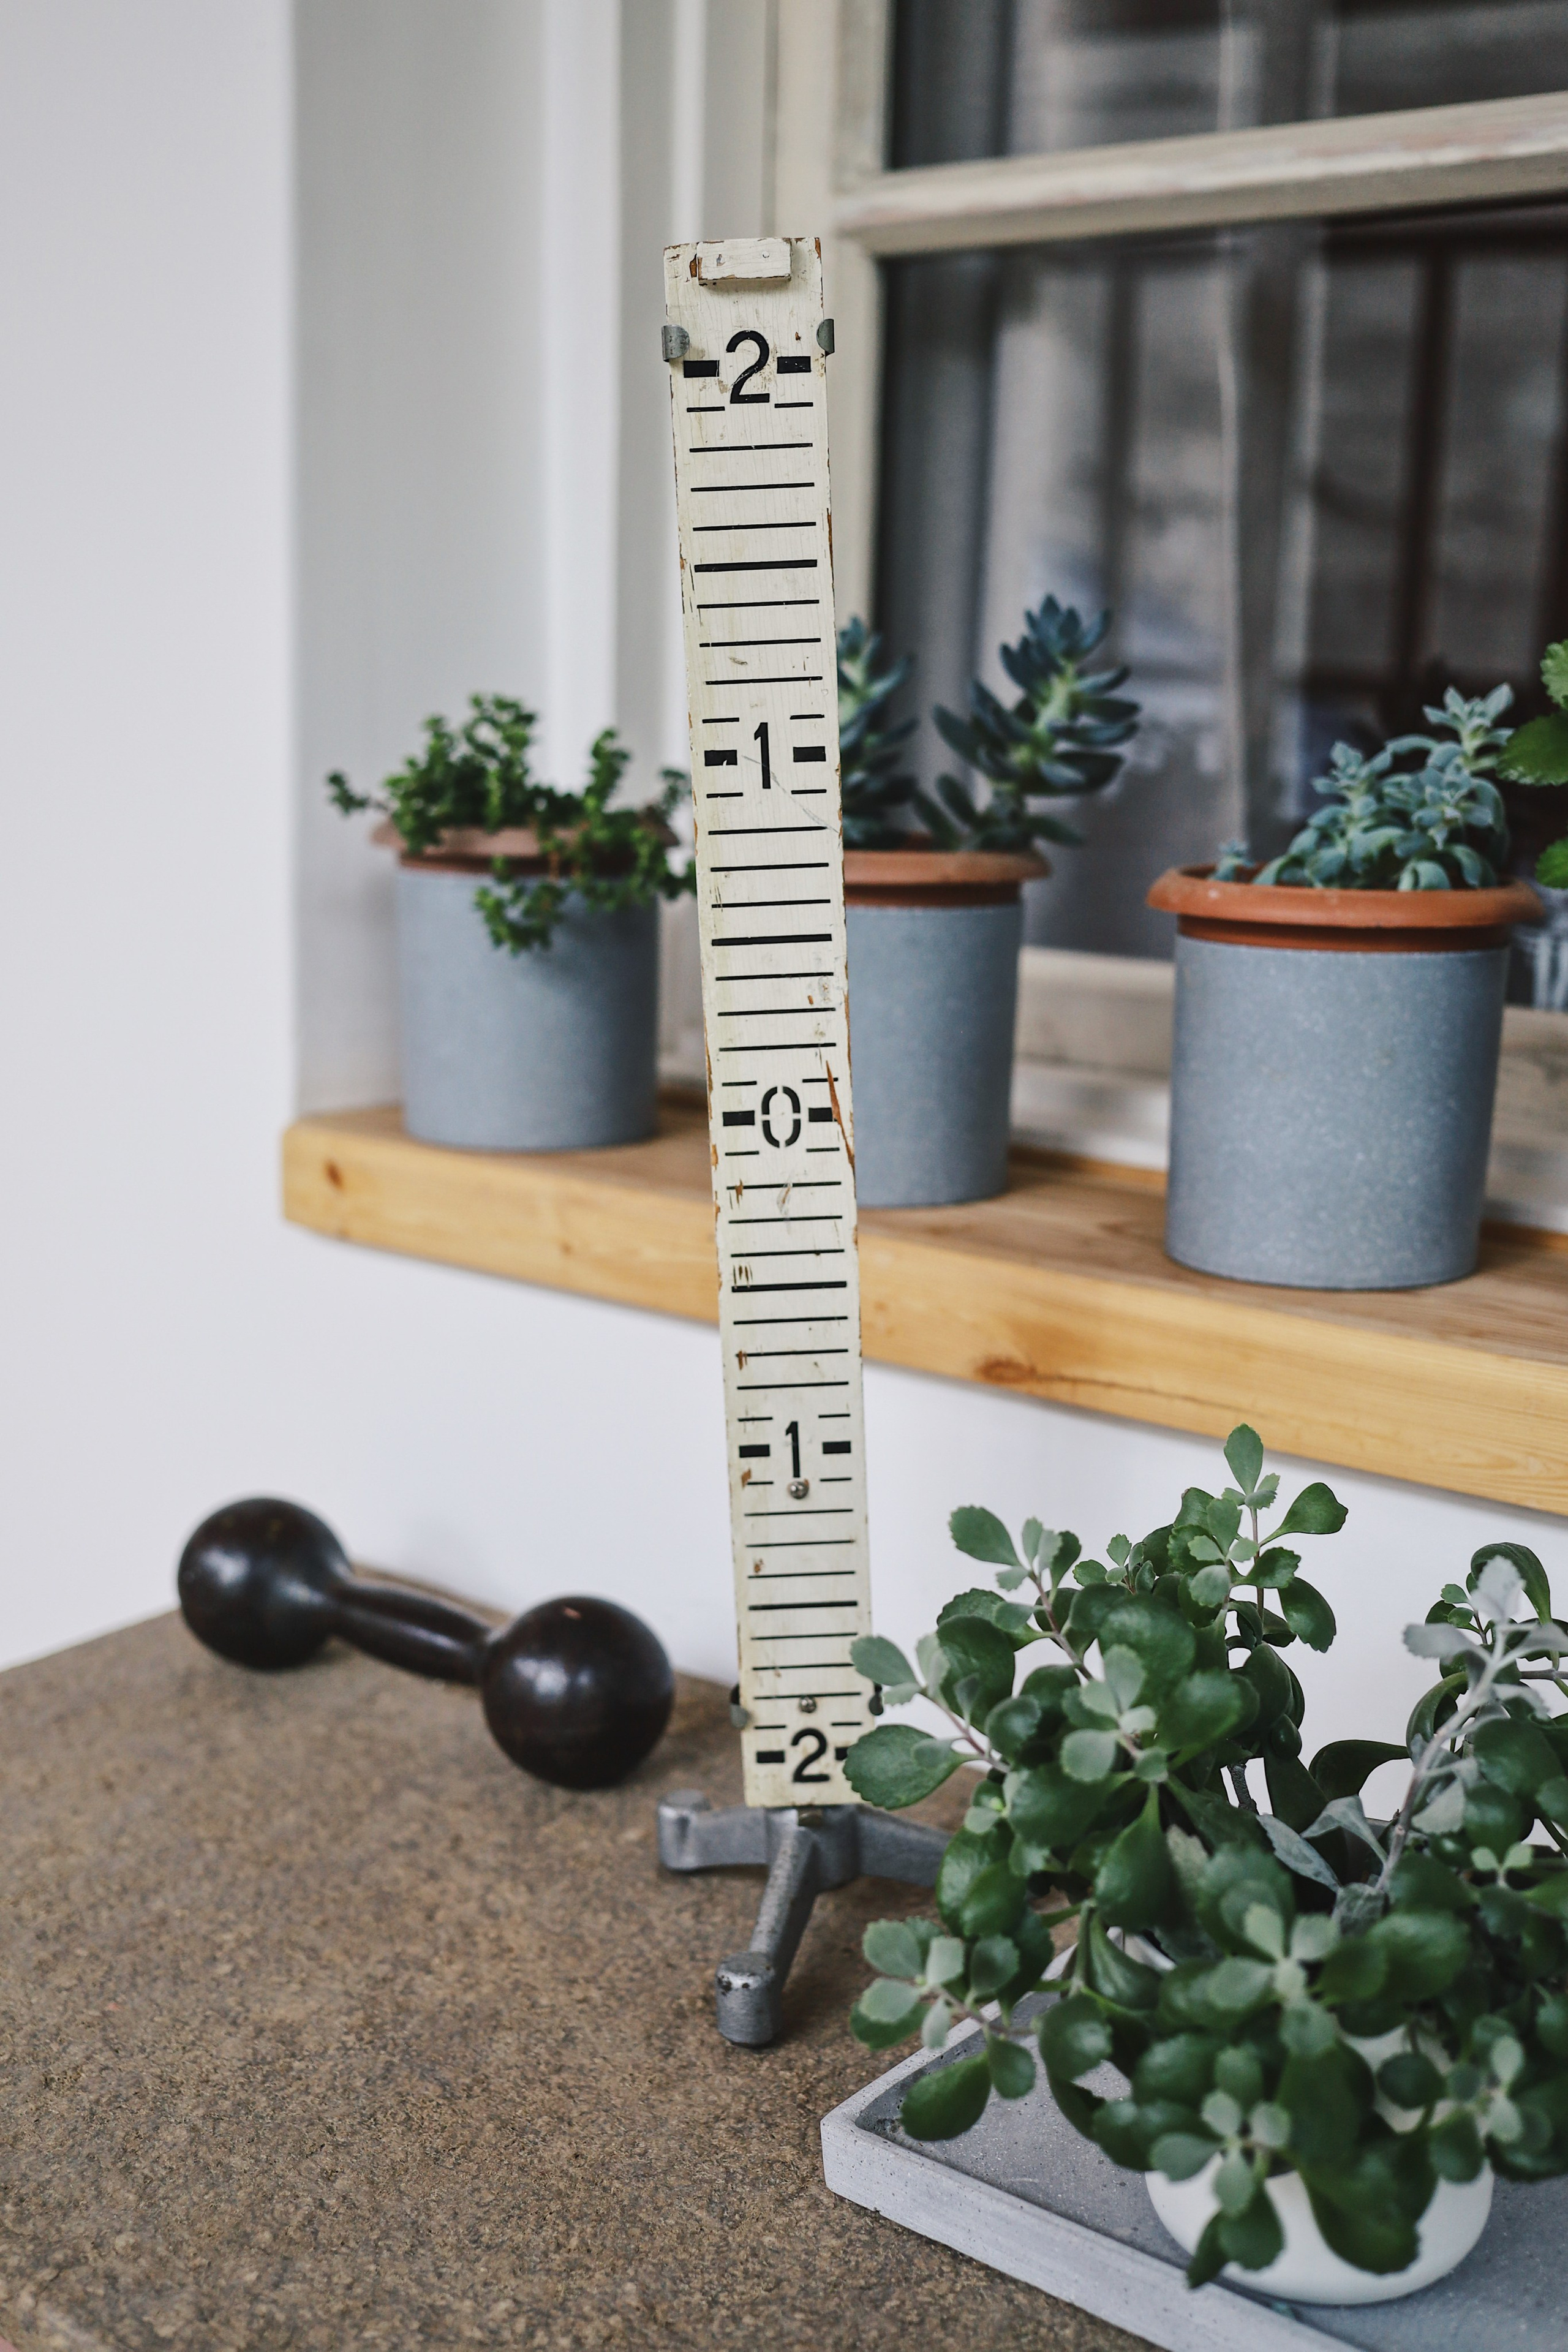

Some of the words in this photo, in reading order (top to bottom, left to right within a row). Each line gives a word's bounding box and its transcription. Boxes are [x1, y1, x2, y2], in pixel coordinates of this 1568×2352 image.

[726, 330, 770, 404] 2
[754, 722, 771, 789] 1
[761, 1086, 801, 1148] 0
[785, 1421, 800, 1478] 1
[791, 1728, 830, 1782] 2
